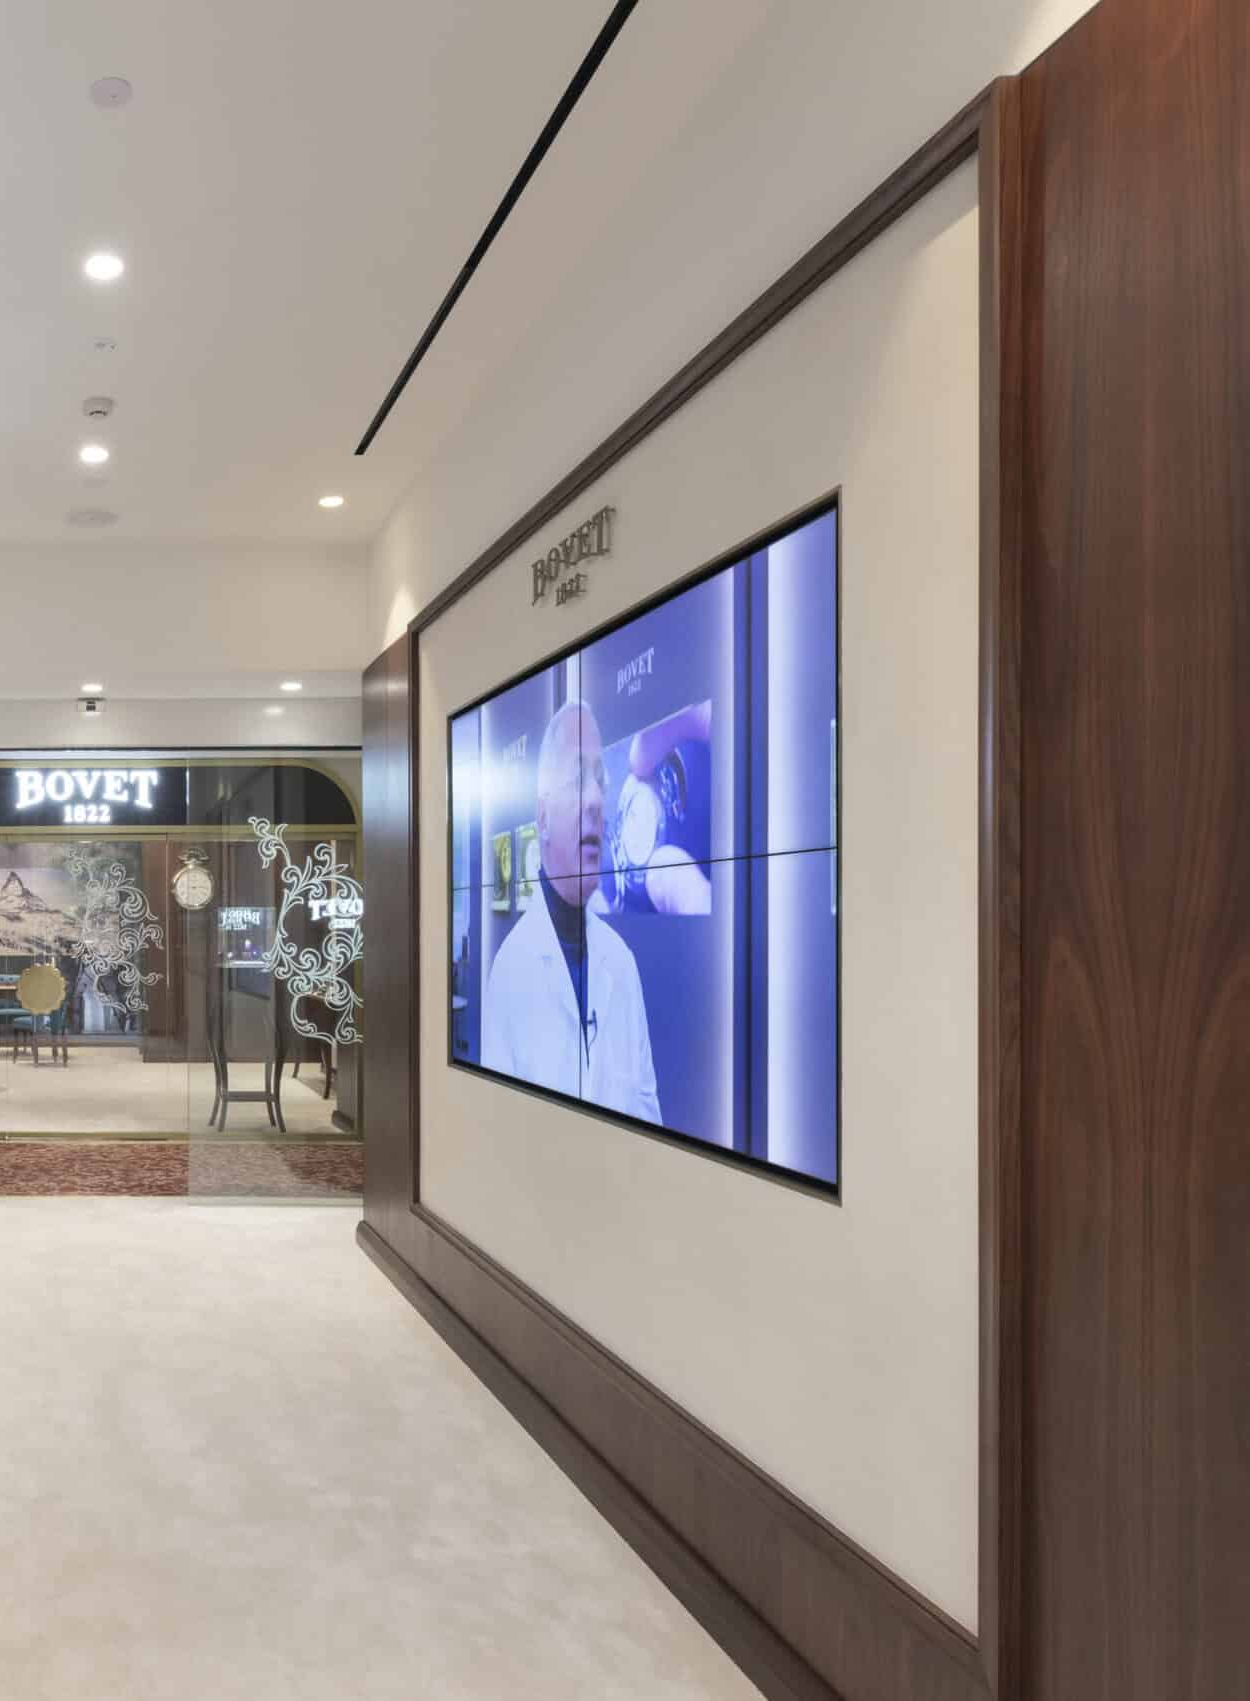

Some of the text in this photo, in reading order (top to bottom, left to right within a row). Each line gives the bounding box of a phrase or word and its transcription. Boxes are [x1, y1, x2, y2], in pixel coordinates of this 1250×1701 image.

[531, 505, 616, 607] BOVET
[616, 647, 655, 695] BOVET
[14, 769, 159, 809] BOVET
[63, 804, 112, 824] 1822
